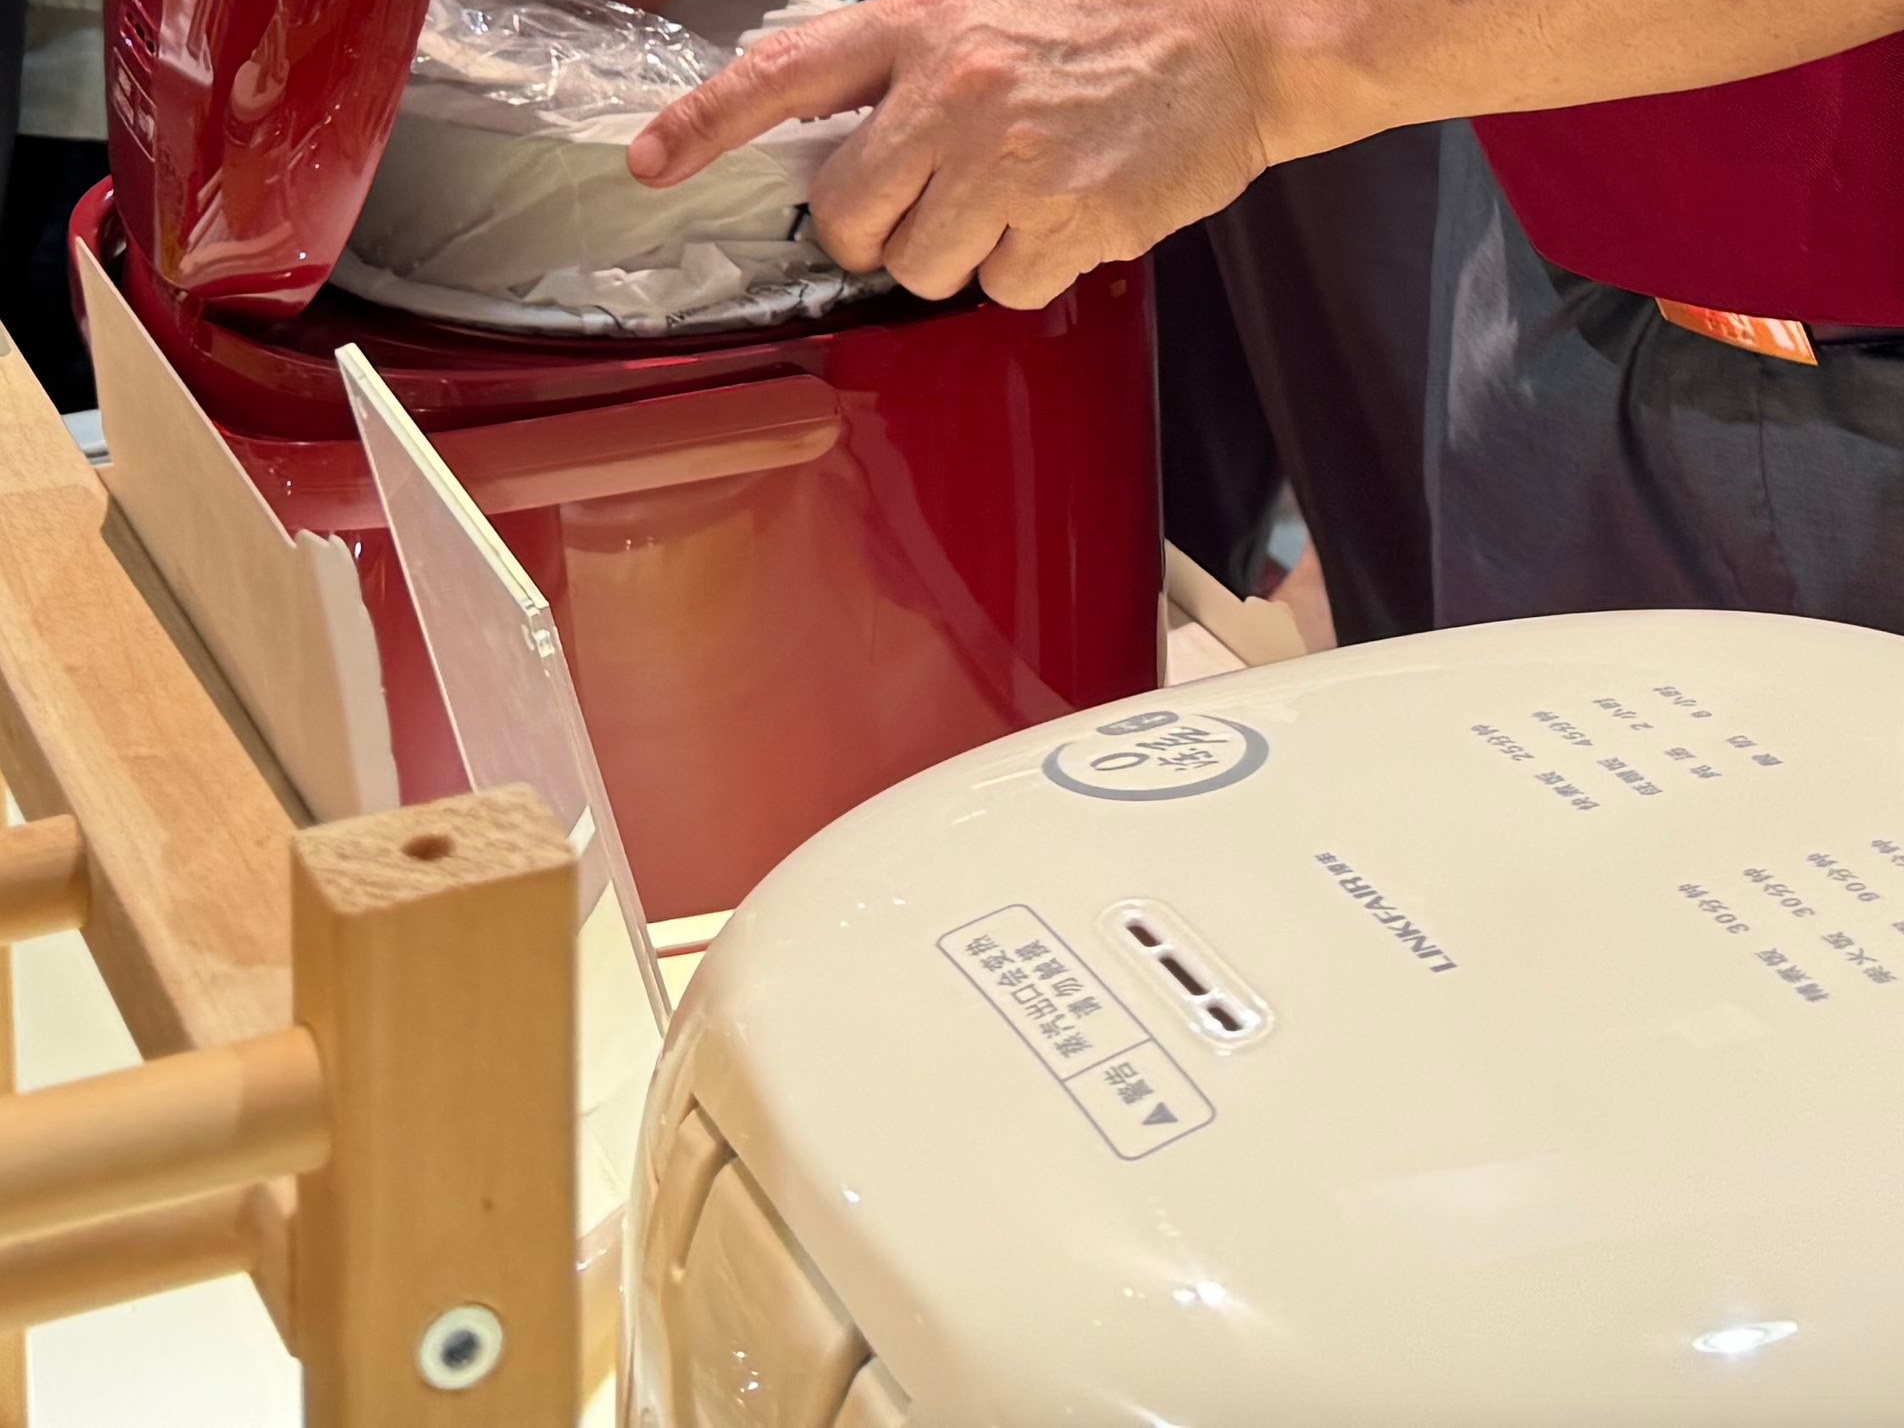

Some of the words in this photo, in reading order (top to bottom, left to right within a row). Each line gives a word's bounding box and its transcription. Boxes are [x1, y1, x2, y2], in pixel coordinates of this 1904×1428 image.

[1471, 724, 1536, 762] 25分钟
[1743, 868, 1816, 918] 30分钟
[1807, 853, 1881, 903] 90分钟
[1338, 876, 1459, 973] LINKFAIR
[1677, 883, 1750, 934] 30分钟
[1015, 938, 1103, 1021] 请勿触摸
[1820, 931, 1898, 984] 柴火饭
[965, 933, 1094, 1060] 蒸汽出口会变热
[1105, 1061, 1155, 1106] 警告
